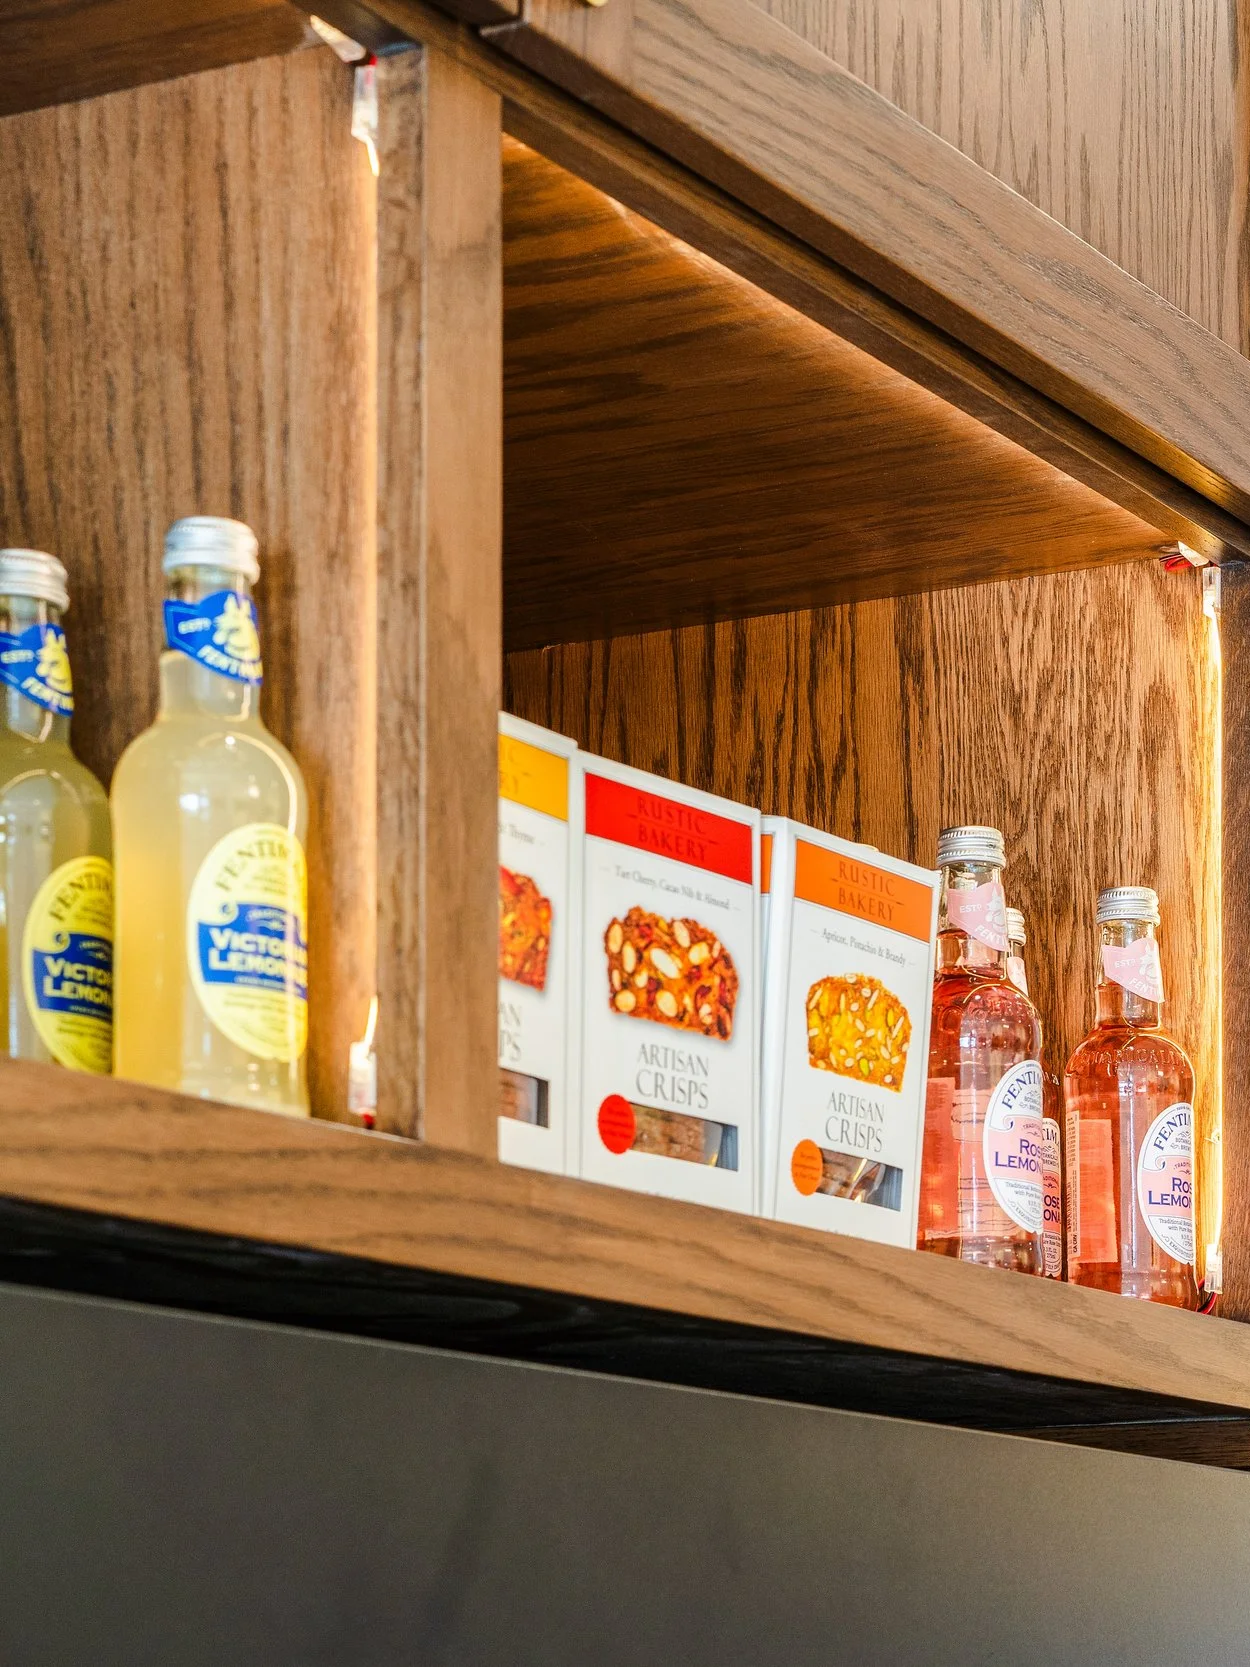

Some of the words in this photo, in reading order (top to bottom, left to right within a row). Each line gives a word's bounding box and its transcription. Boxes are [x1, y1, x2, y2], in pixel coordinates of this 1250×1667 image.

[638, 796, 707, 835] RUSTIC
[638, 822, 707, 862] BAKERY
[839, 861, 896, 897] RUSTIC
[839, 887, 895, 921] BAKERY
[637, 1042, 710, 1078] ARTISAN
[636, 1068, 710, 1110] CRISPS
[826, 1089, 885, 1124] ARTISAN
[825, 1115, 884, 1153] CRISPS
